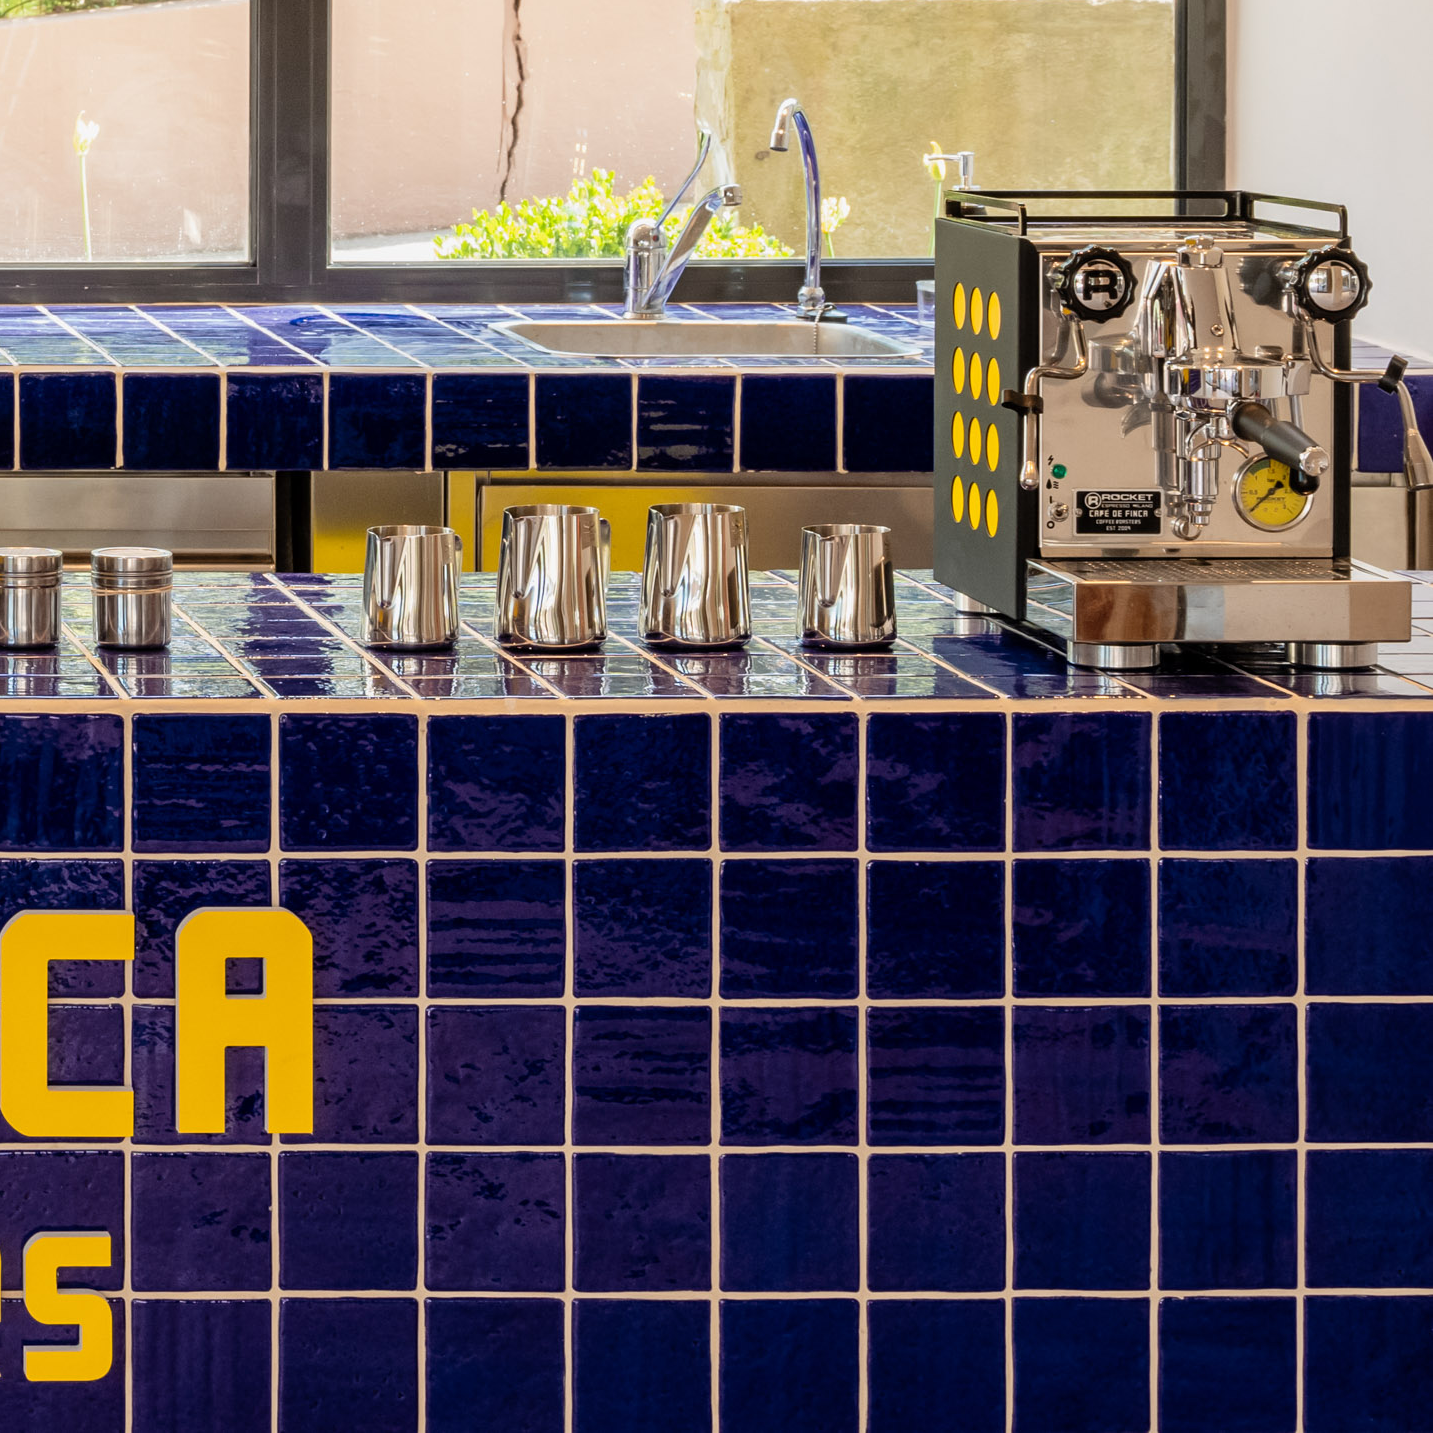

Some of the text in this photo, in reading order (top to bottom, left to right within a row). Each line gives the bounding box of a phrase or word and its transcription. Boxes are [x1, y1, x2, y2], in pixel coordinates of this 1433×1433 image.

[1089, 509, 1149, 518] CAFÉ DE FINCA
